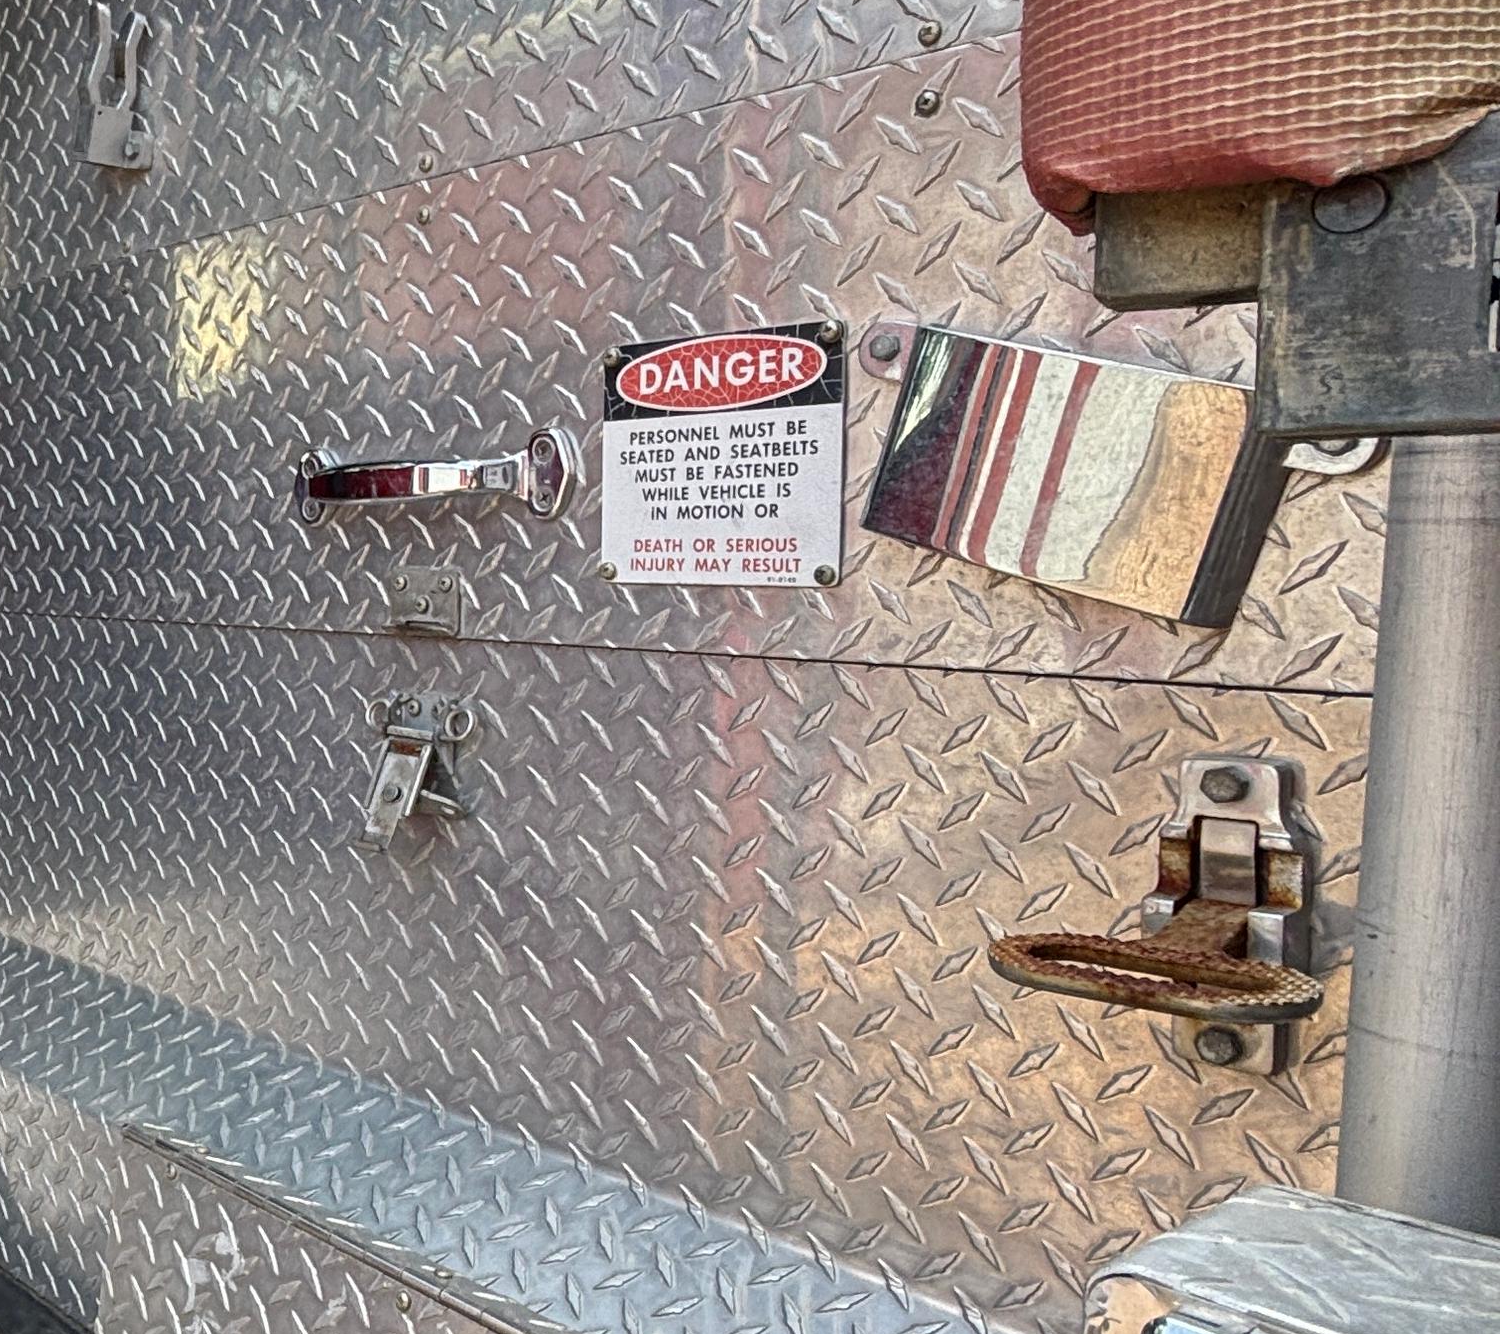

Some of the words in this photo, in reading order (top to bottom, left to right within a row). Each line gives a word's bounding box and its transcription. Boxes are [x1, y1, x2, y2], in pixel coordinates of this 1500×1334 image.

[639, 346, 804, 396] DANGER
[629, 426, 720, 445] PERSONNEL
[729, 422, 775, 439] MUST
[786, 420, 807, 435] BE
[620, 449, 675, 465] SEATED
[684, 446, 720, 461] AND
[730, 440, 819, 459] SEATBELTS
[634, 468, 675, 484] MUST
[685, 466, 704, 480] BE
[714, 462, 799, 479] FASTENED
[642, 487, 689, 502] WHILE
[699, 484, 766, 501] VEHICLE
[776, 482, 791, 497] IS
[651, 506, 667, 520] IN
[676, 504, 744, 520] MOTION
[754, 503, 779, 518] OR
[633, 538, 683, 553] DEATH
[692, 538, 715, 553] OR
[726, 537, 797, 553] SERIOUS
[630, 558, 685, 572] INJURY
[694, 558, 731, 572] MAY
[742, 557, 802, 573] RESULT
